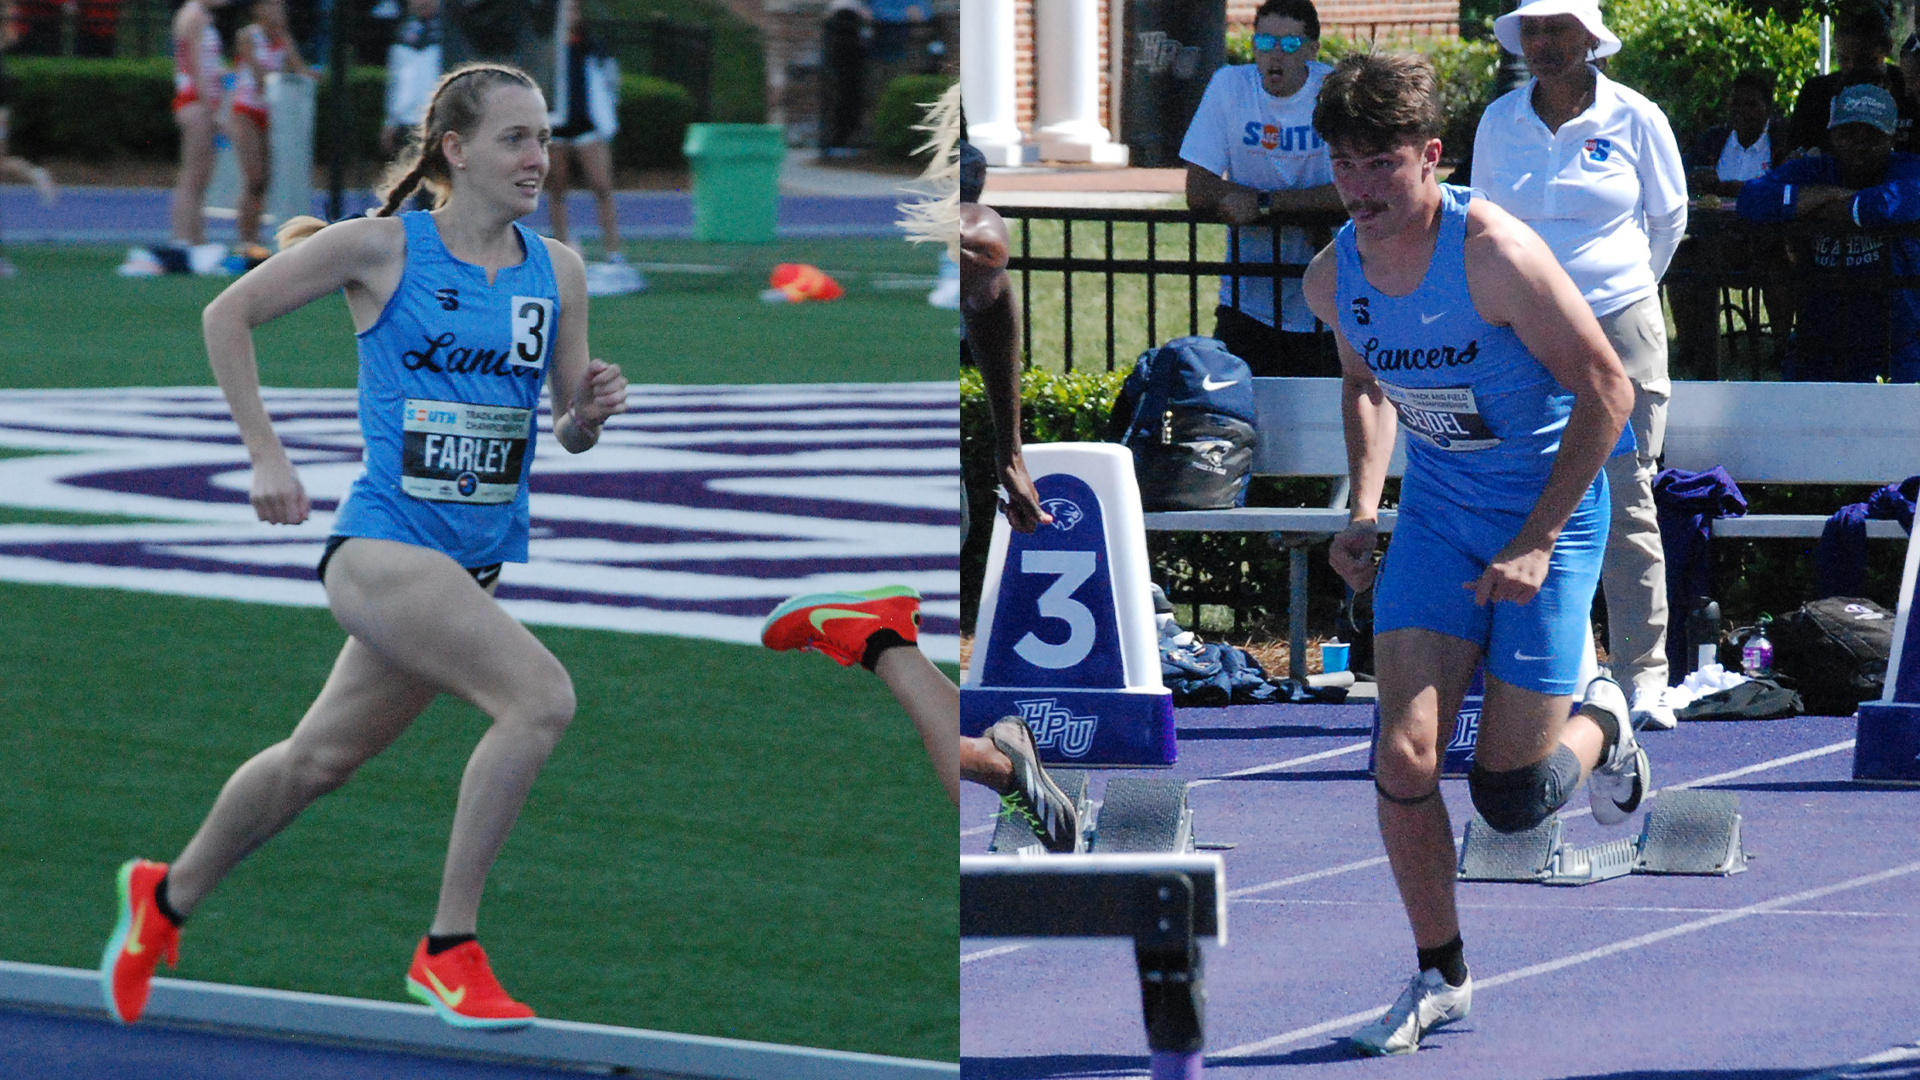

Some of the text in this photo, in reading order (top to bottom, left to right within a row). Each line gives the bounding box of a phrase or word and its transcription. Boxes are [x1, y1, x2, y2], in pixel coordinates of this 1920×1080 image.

[517, 302, 545, 362] 3
[1360, 337, 1480, 372] Lancers
[1400, 404, 1470, 434] SEIDEL
[424, 434, 513, 473] FARLEY
[1013, 550, 1096, 669] 3
[1013, 698, 1098, 758] HPU
